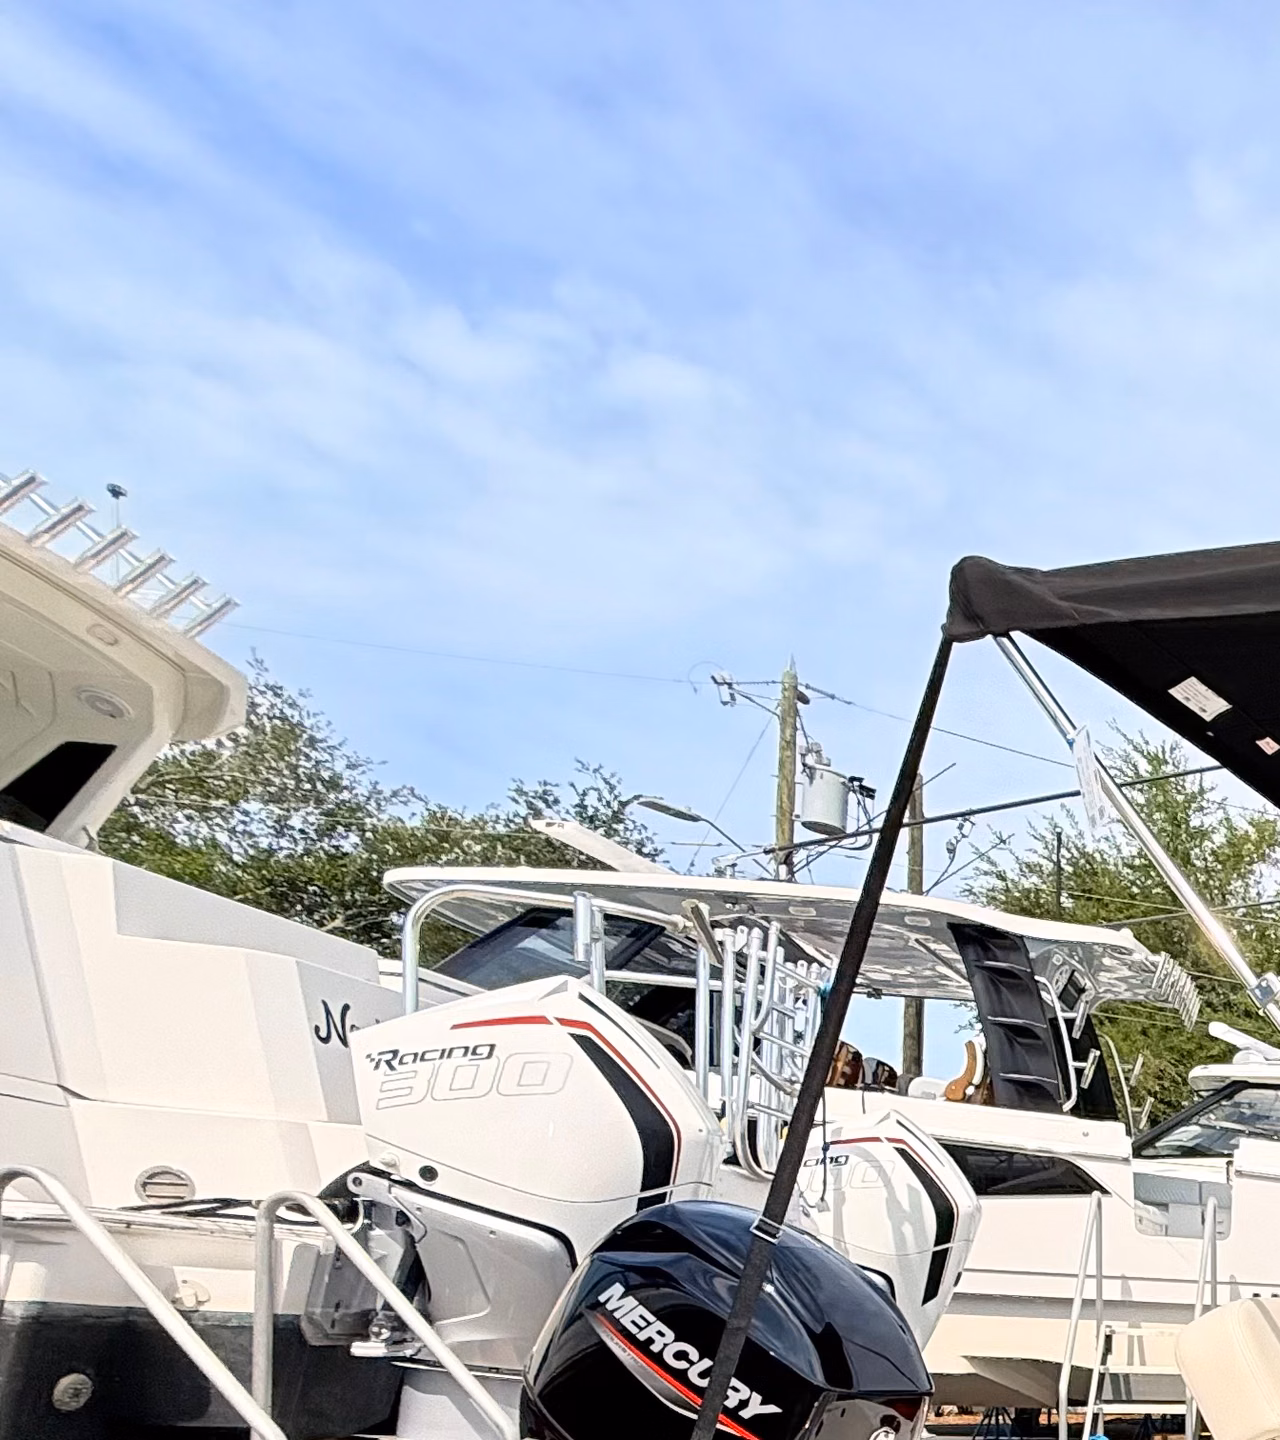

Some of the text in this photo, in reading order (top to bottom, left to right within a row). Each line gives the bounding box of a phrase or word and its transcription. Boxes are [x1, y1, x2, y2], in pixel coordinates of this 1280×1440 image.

[366, 1043, 497, 1072] Racing
[375, 1052, 574, 1110] 300
[803, 1155, 850, 1168] acing
[597, 1282, 783, 1420] MERCURY
